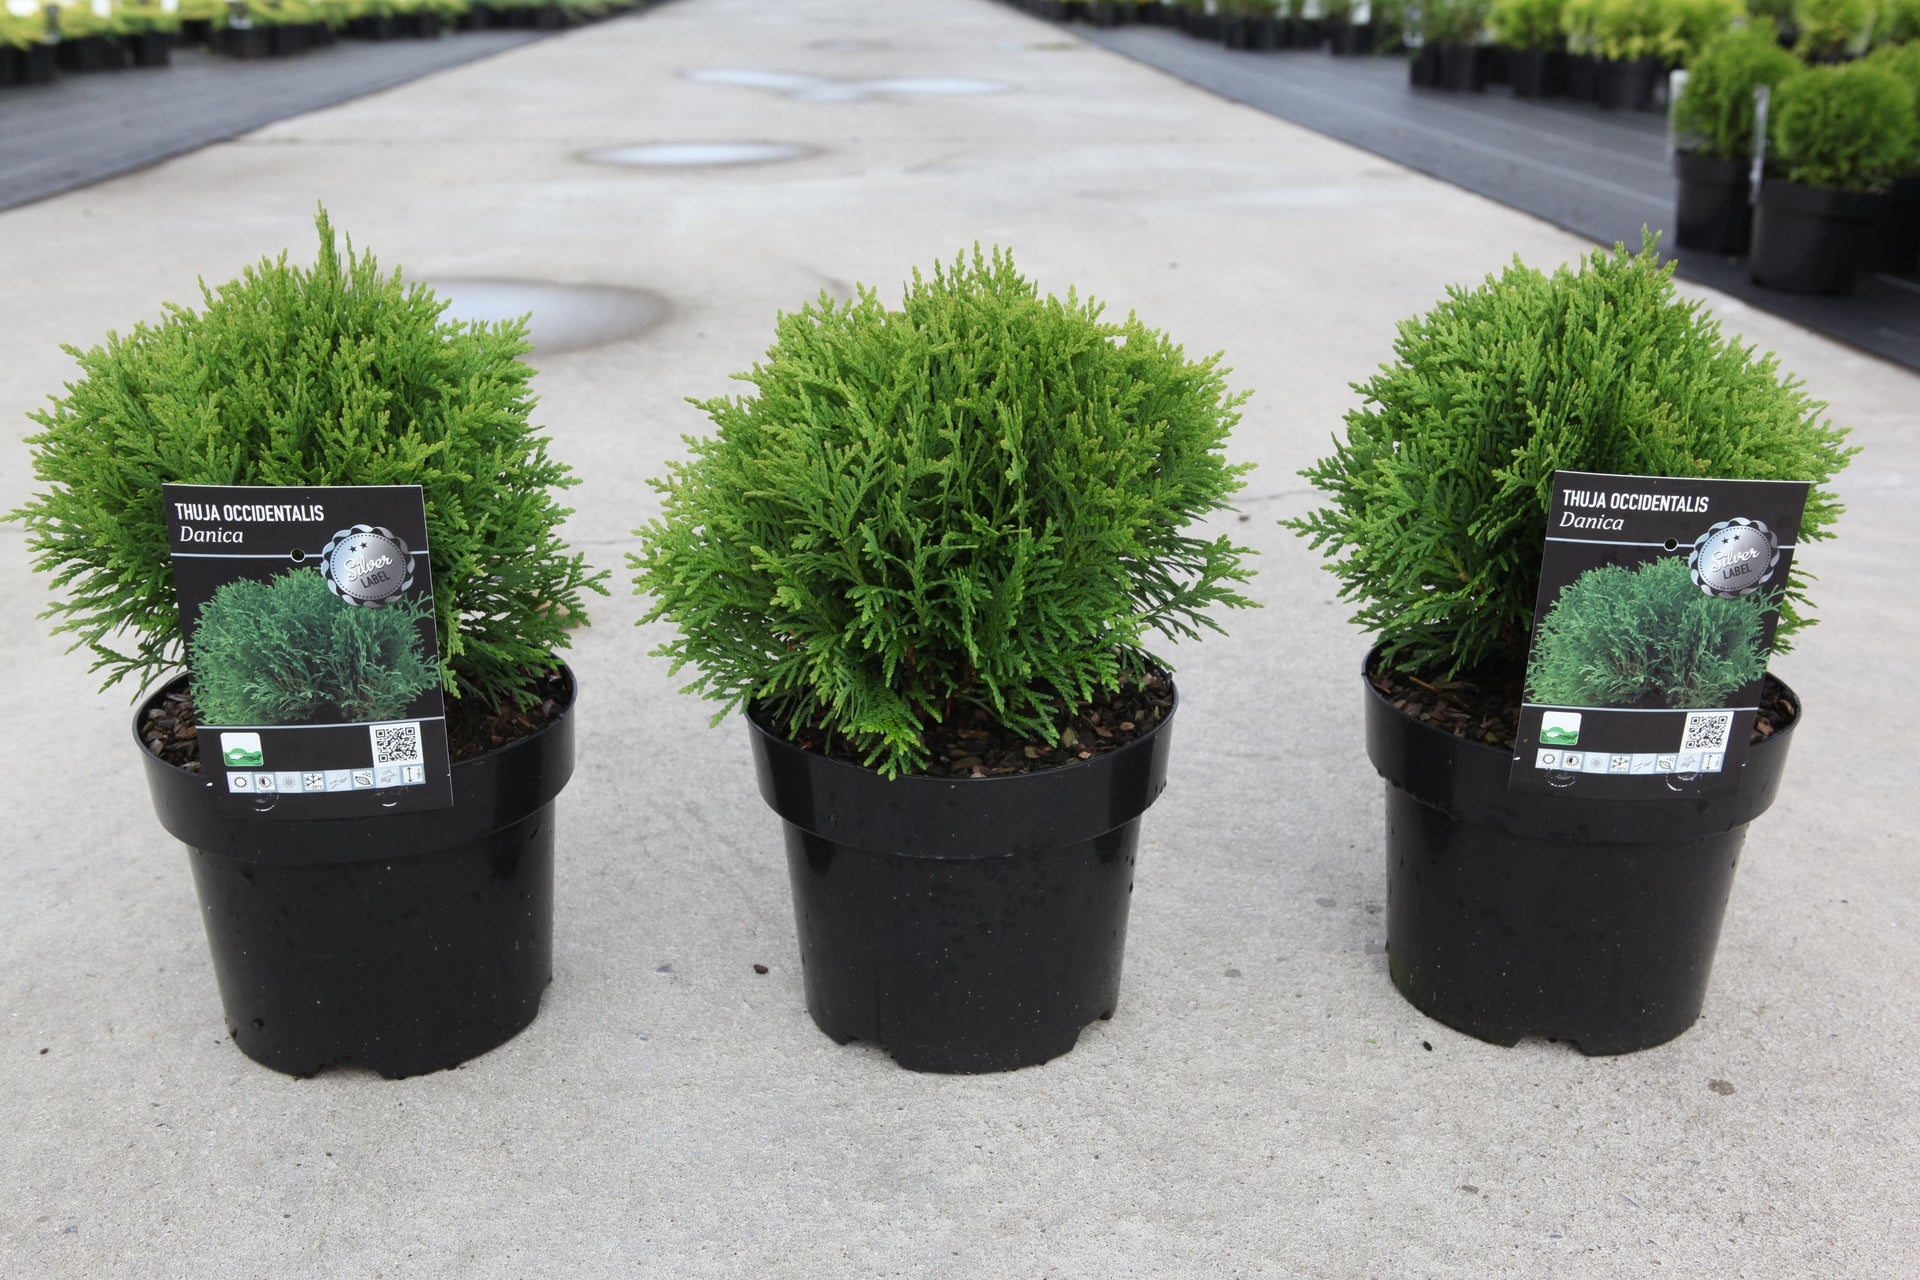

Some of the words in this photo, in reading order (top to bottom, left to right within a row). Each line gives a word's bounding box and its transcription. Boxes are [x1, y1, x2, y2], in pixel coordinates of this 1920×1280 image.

[1563, 489, 1606, 509] THUJA
[1610, 492, 1709, 513] OCCIDENTALIS
[174, 502, 221, 521] THUJA
[223, 504, 325, 522] OCCIDENTALIS
[1559, 511, 1625, 531] Danica
[180, 525, 244, 543] Danica
[343, 553, 393, 582] Silver
[1710, 547, 1760, 573] Silver
[360, 572, 391, 589] LABEL
[1722, 563, 1753, 580] LABEL
